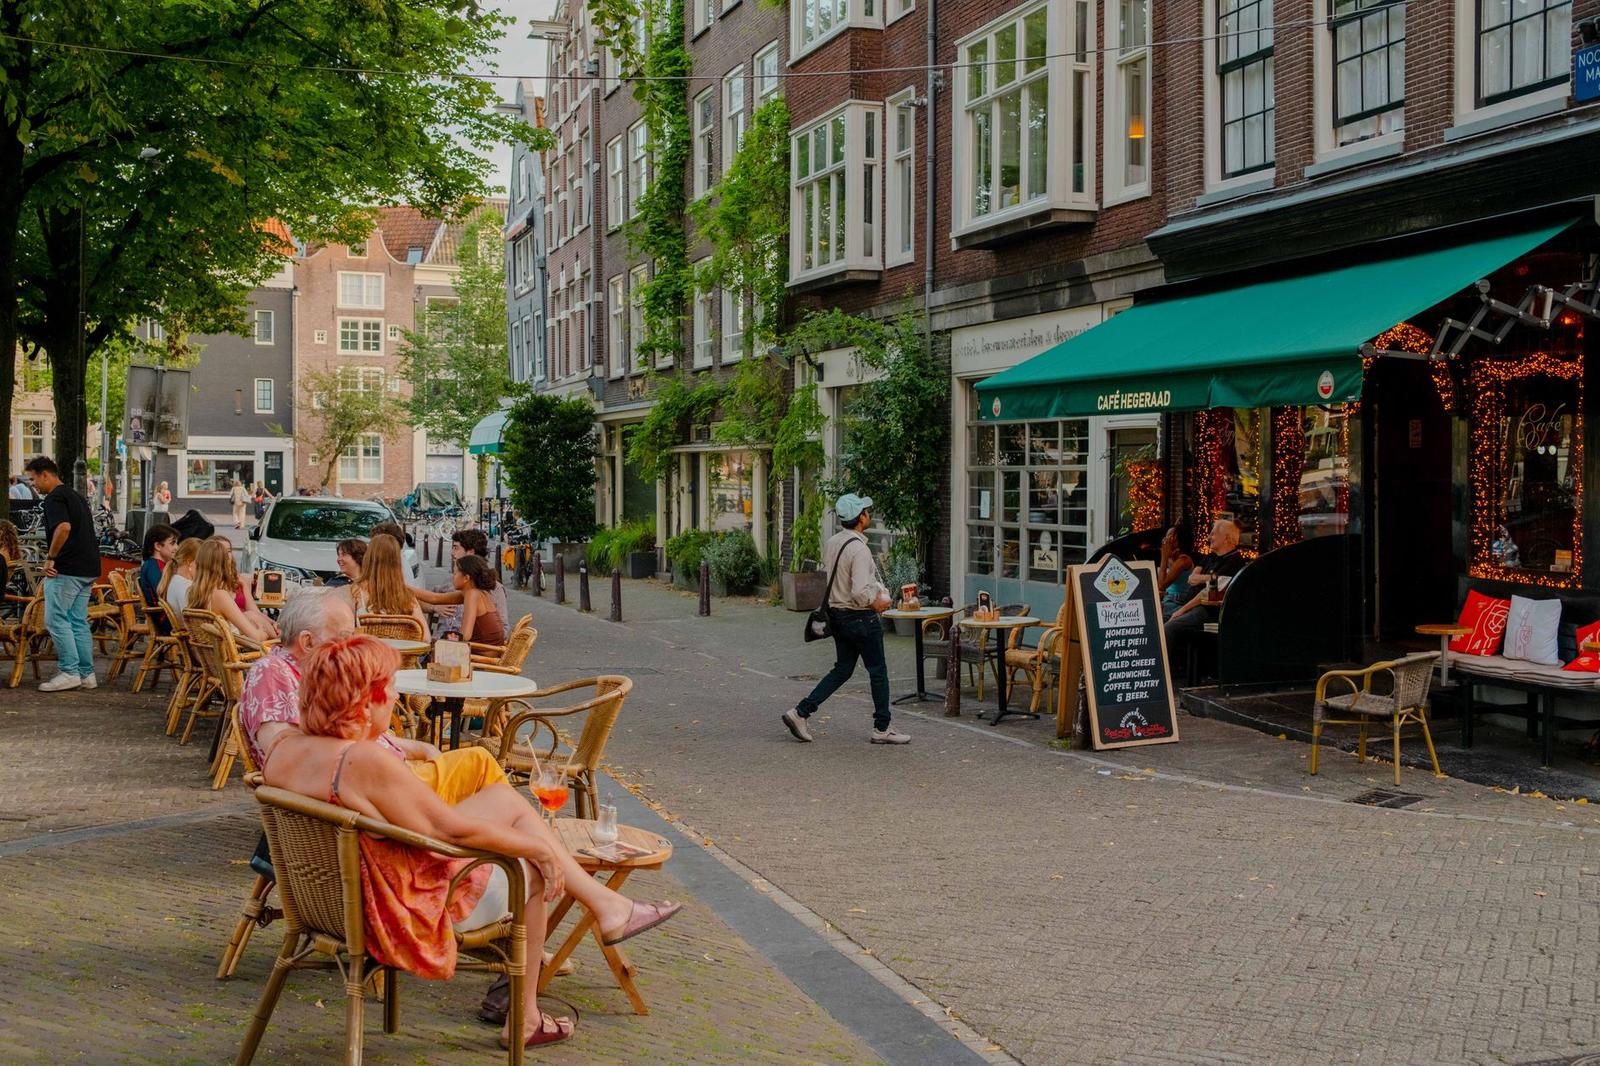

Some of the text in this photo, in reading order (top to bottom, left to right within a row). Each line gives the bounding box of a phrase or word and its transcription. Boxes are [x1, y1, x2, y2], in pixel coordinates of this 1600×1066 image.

[1097, 389, 1171, 411] CAFÉ HEGERAAD
[1105, 627, 1144, 639] HOMEMADE
[1104, 638, 1148, 650] APPLE PIE!!!
[1102, 658, 1156, 671] GRILLED CHEESE
[1134, 679, 1160, 690] PASTRY
